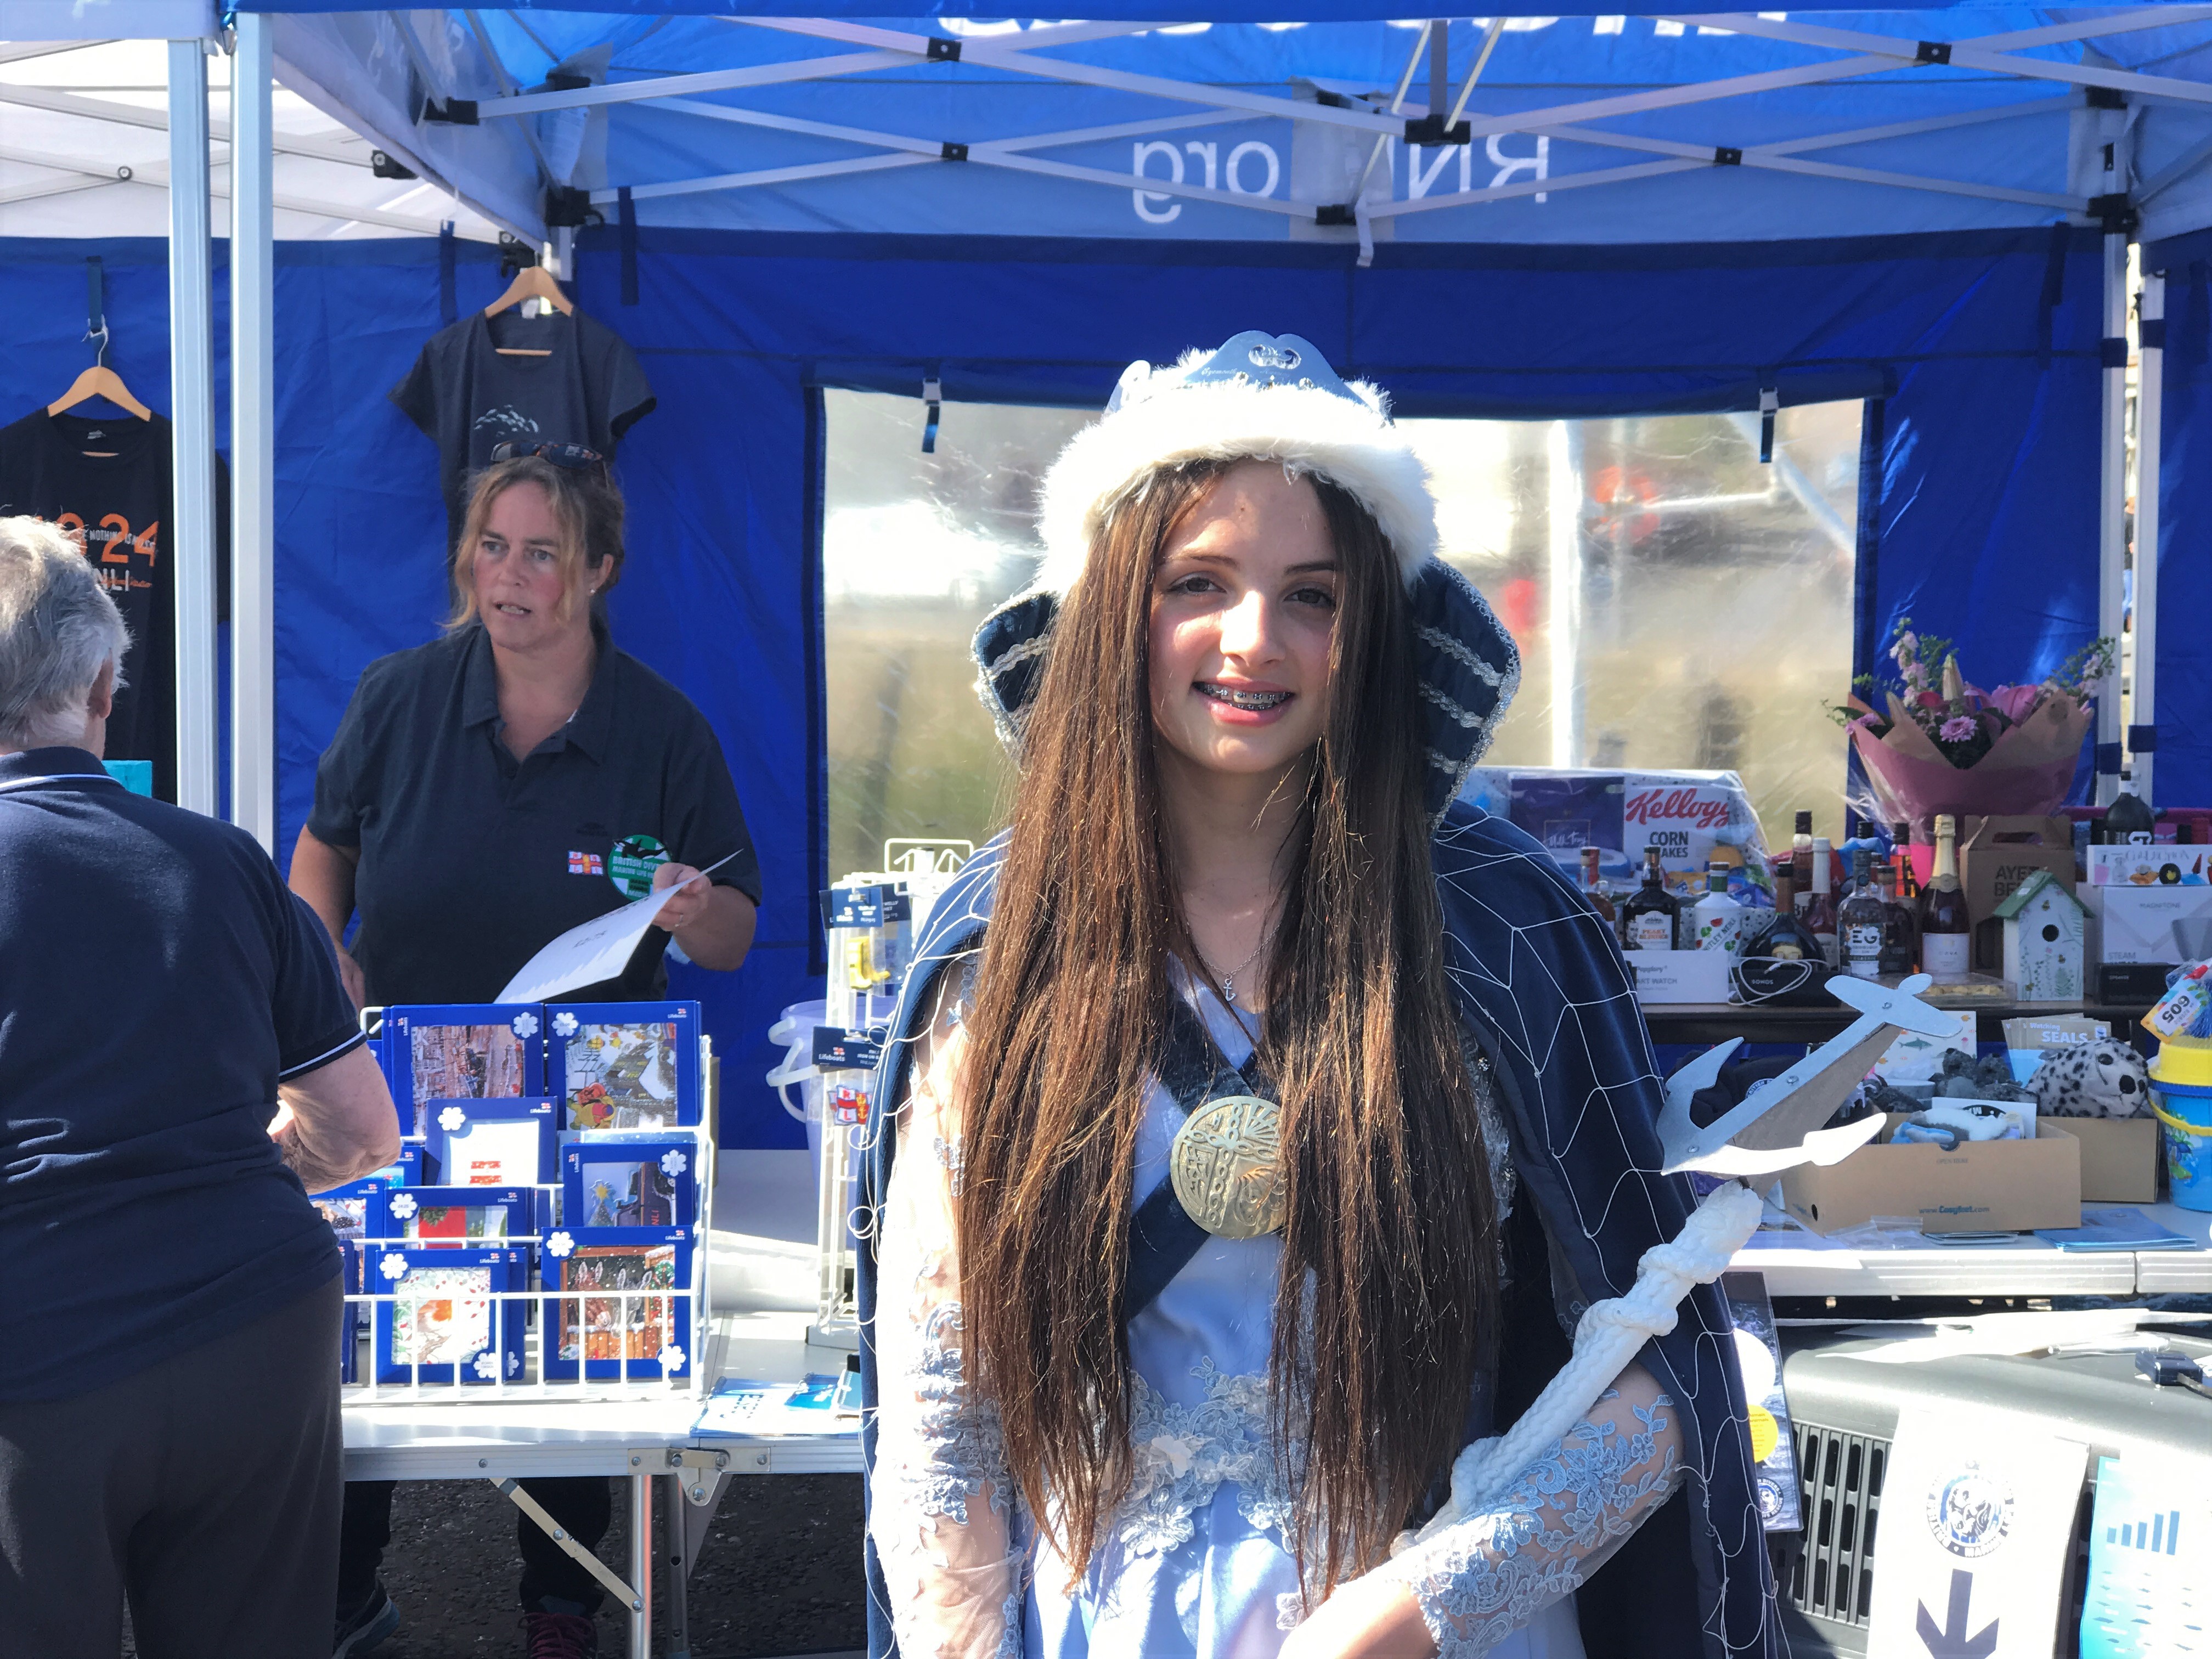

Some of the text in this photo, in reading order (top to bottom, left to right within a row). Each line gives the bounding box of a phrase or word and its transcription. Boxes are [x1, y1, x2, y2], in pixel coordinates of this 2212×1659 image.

[94, 567, 129, 591] NLI
[1650, 831, 1688, 846] CORN
[1661, 847, 1688, 858] AKES
[2042, 1030, 2089, 1044] SEALS
[818, 1053, 846, 1062] Lifeboats
[1763, 1479, 1780, 1492] DIVERS
[1771, 1497, 1784, 1516] RESCUE
